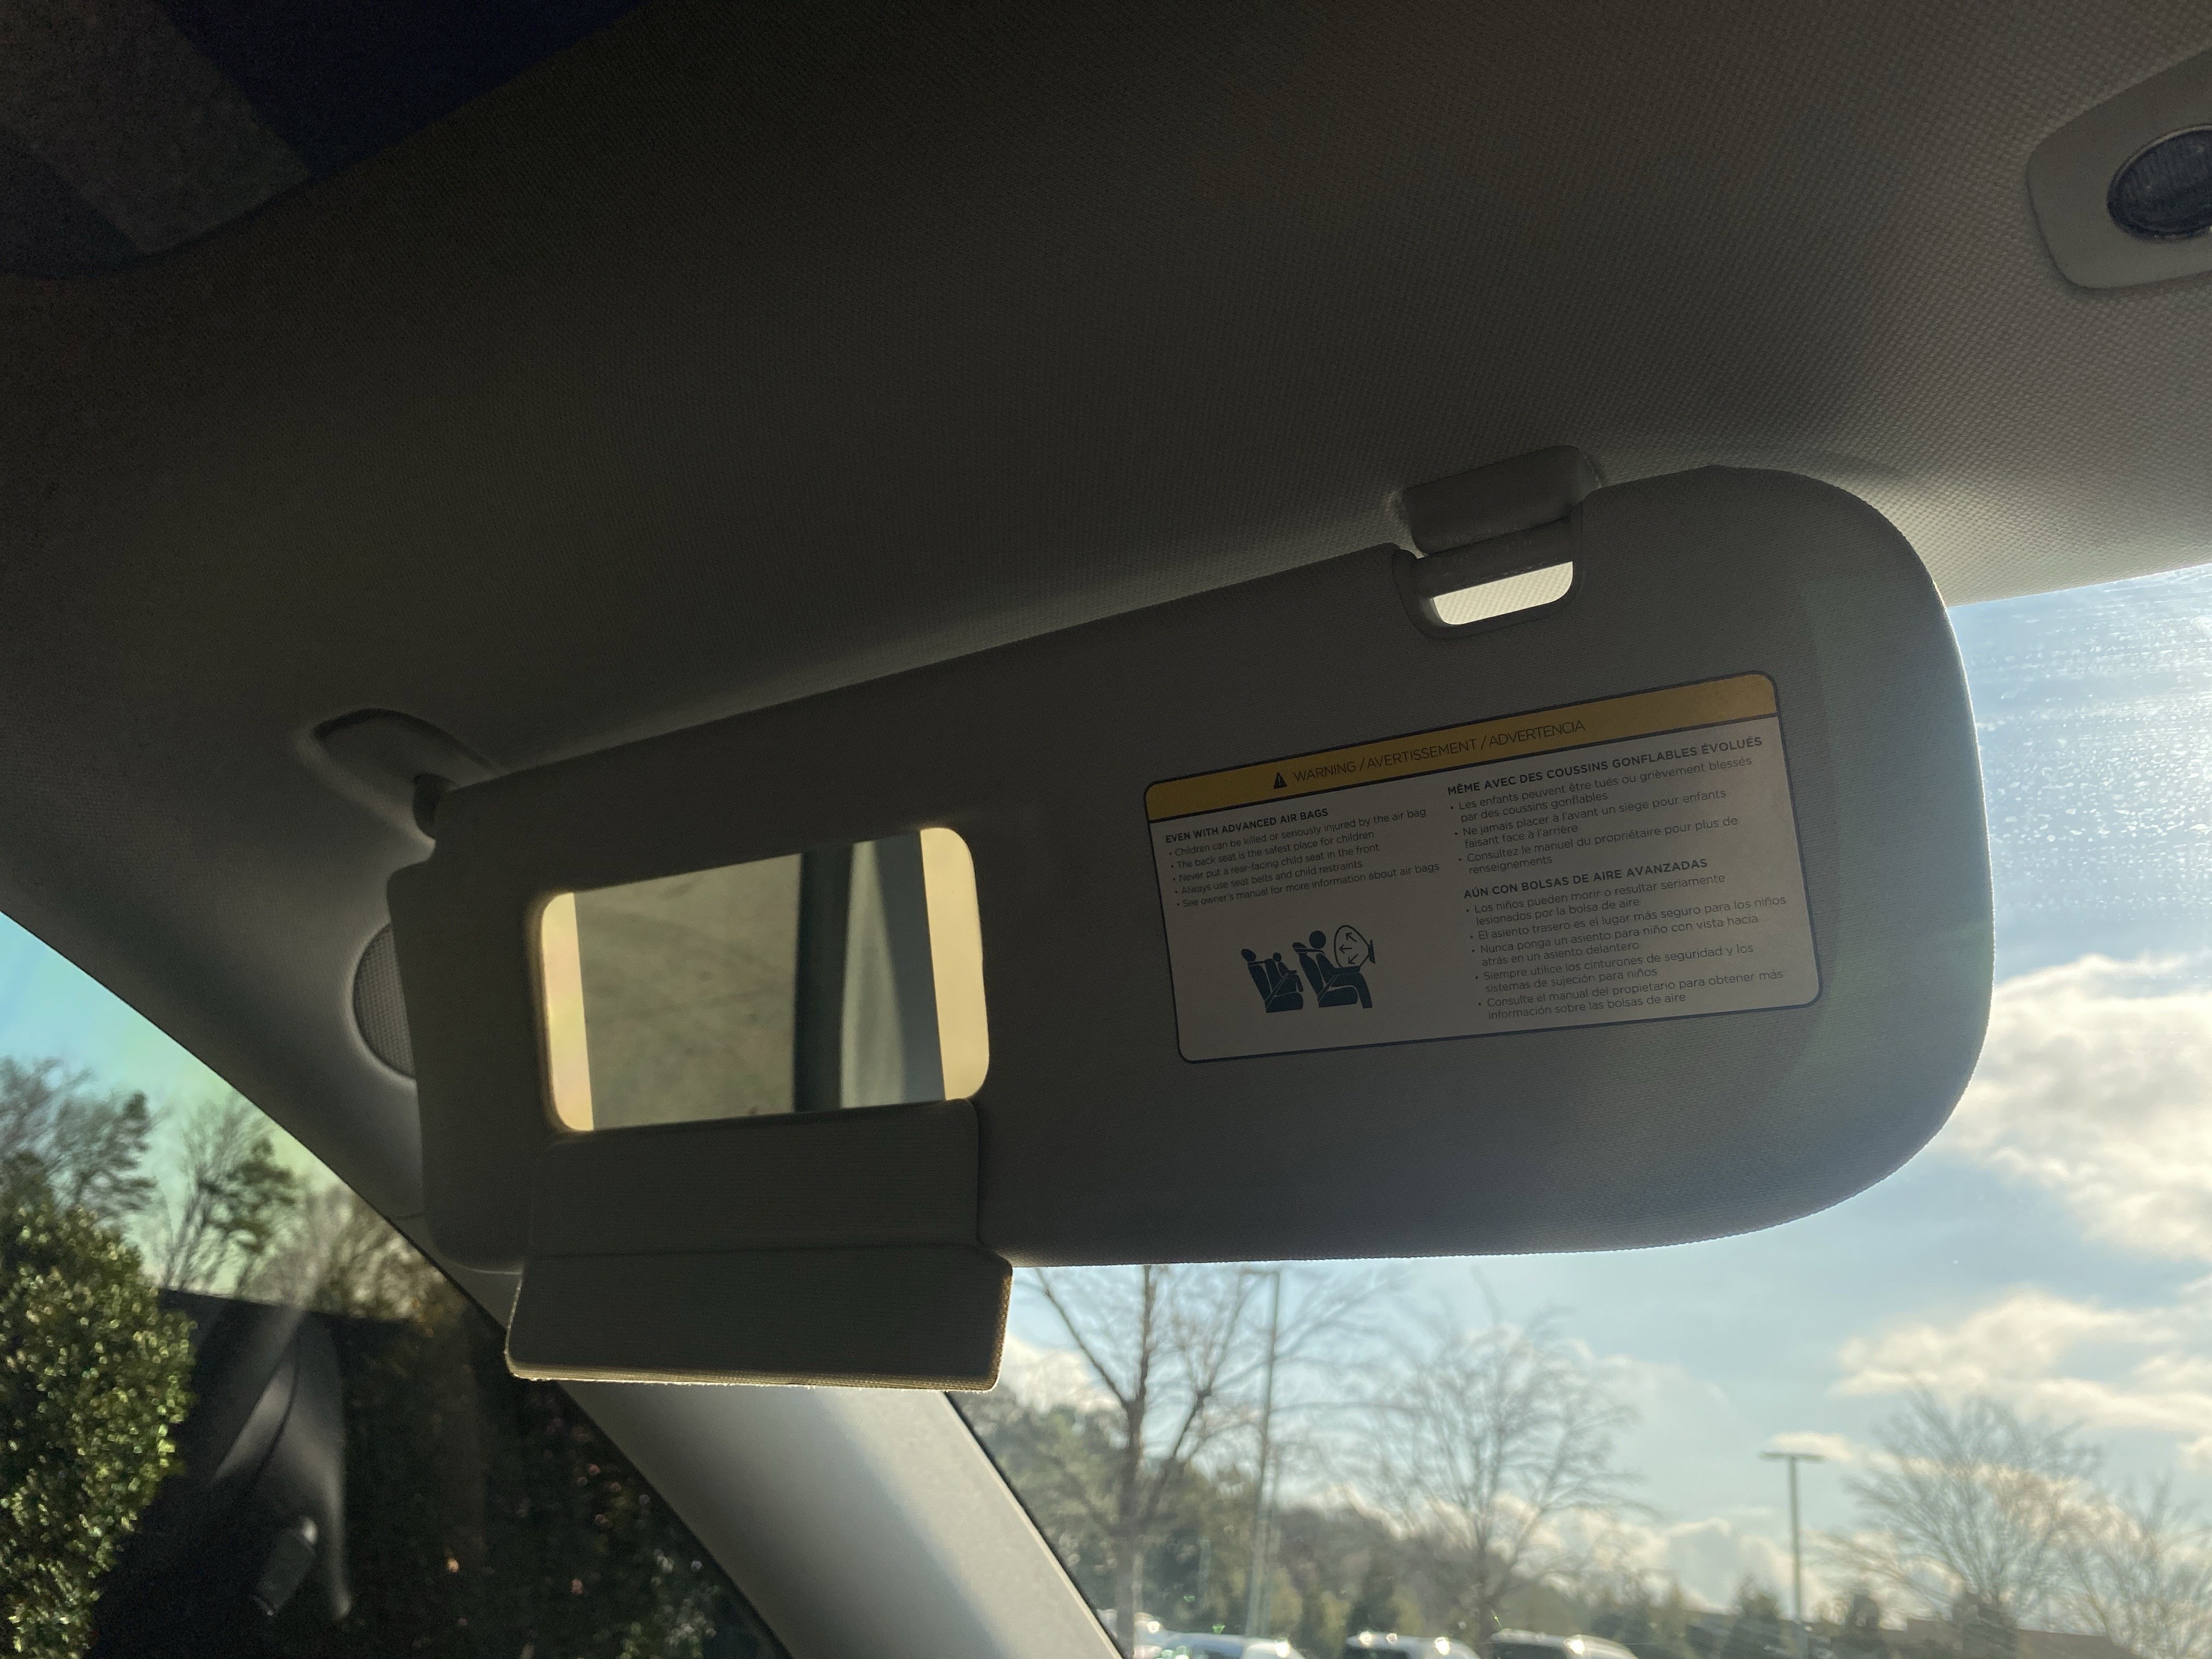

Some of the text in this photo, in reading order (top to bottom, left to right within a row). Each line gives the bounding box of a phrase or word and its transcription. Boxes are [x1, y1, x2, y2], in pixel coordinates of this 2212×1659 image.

[1293, 760, 1356, 782] WARNING
[1447, 781, 1481, 795] MÊME
[1484, 776, 1516, 789] AVEC
[1520, 771, 1543, 783] DES
[1546, 760, 1608, 778] COUSSINS
[1612, 746, 1697, 768] GONFLABLES
[1459, 800, 1477, 810] Les
[1480, 793, 1519, 806] enfants
[1522, 785, 1566, 801] peuvent
[1622, 775, 1637, 784] ou
[1461, 792, 1608, 823] par des coussins gonflables
[1165, 808, 1329, 843] EVEN WITH ADVANCED AIR BAGS
[1463, 826, 1477, 836] Ne
[1481, 822, 1514, 835] jamais
[1516, 816, 1549, 829] placer
[1601, 806, 1616, 815] un
[1652, 797, 1679, 809] pour
[1683, 790, 1726, 803] enfants
[1175, 844, 1210, 856] Children
[1212, 842, 1228, 850] can
[1243, 833, 1267, 844] killed
[1281, 825, 1321, 839] seriously
[1324, 818, 1356, 832] injured
[1358, 817, 1370, 827] by
[1373, 815, 1389, 823] the
[1392, 812, 1404, 821] air
[1407, 809, 1426, 818] bag
[1177, 831, 1374, 869] The back seat the safest place children
[1465, 835, 1499, 848] faisant
[1502, 833, 1525, 842] face
[1467, 816, 1737, 862] Consultez le manuel du propriétaire pour plus de
[1178, 872, 1204, 882] Never
[1206, 868, 1221, 878] put
[1231, 860, 1279, 873] rear-facing
[1281, 855, 1303, 866] child
[1305, 851, 1324, 862] seat
[1356, 843, 1380, 853] front
[1181, 860, 1363, 894] Always seat belts and child restraints
[1464, 858, 1707, 899] AÚN CON BOLSAS DE AIRE AVANZADAS
[1469, 856, 1553, 874] renseignements
[1236, 887, 1268, 899] manual
[1286, 882, 1310, 891] more
[1312, 874, 1366, 888] information
[1369, 868, 1397, 880] about
[1400, 867, 1412, 876] air
[1414, 863, 1440, 873] bags
[1475, 874, 1725, 913] Los niños pueden morir resultar seriamente
[1476, 899, 1640, 925] lesionados por la bolsa de aire
[1491, 896, 1786, 938] asiento trasero es lugar más seguro para los niños
[1480, 916, 1758, 953] Nunca ponga un asiento para niño con vista hacia
[1482, 942, 1639, 966] atrás en un asiento delantero
[1483, 944, 1753, 980] Siempre utilice los cinturones de seguridad los
[1485, 981, 1531, 992] sistemas
[1534, 978, 1547, 988] de
[1599, 972, 1623, 982] para
[1627, 968, 1657, 978] niños
[1487, 969, 1784, 1007] Consulte el manual del propietario para obtener más
[1488, 994, 1686, 1019] información sobre las bolsas de aire
